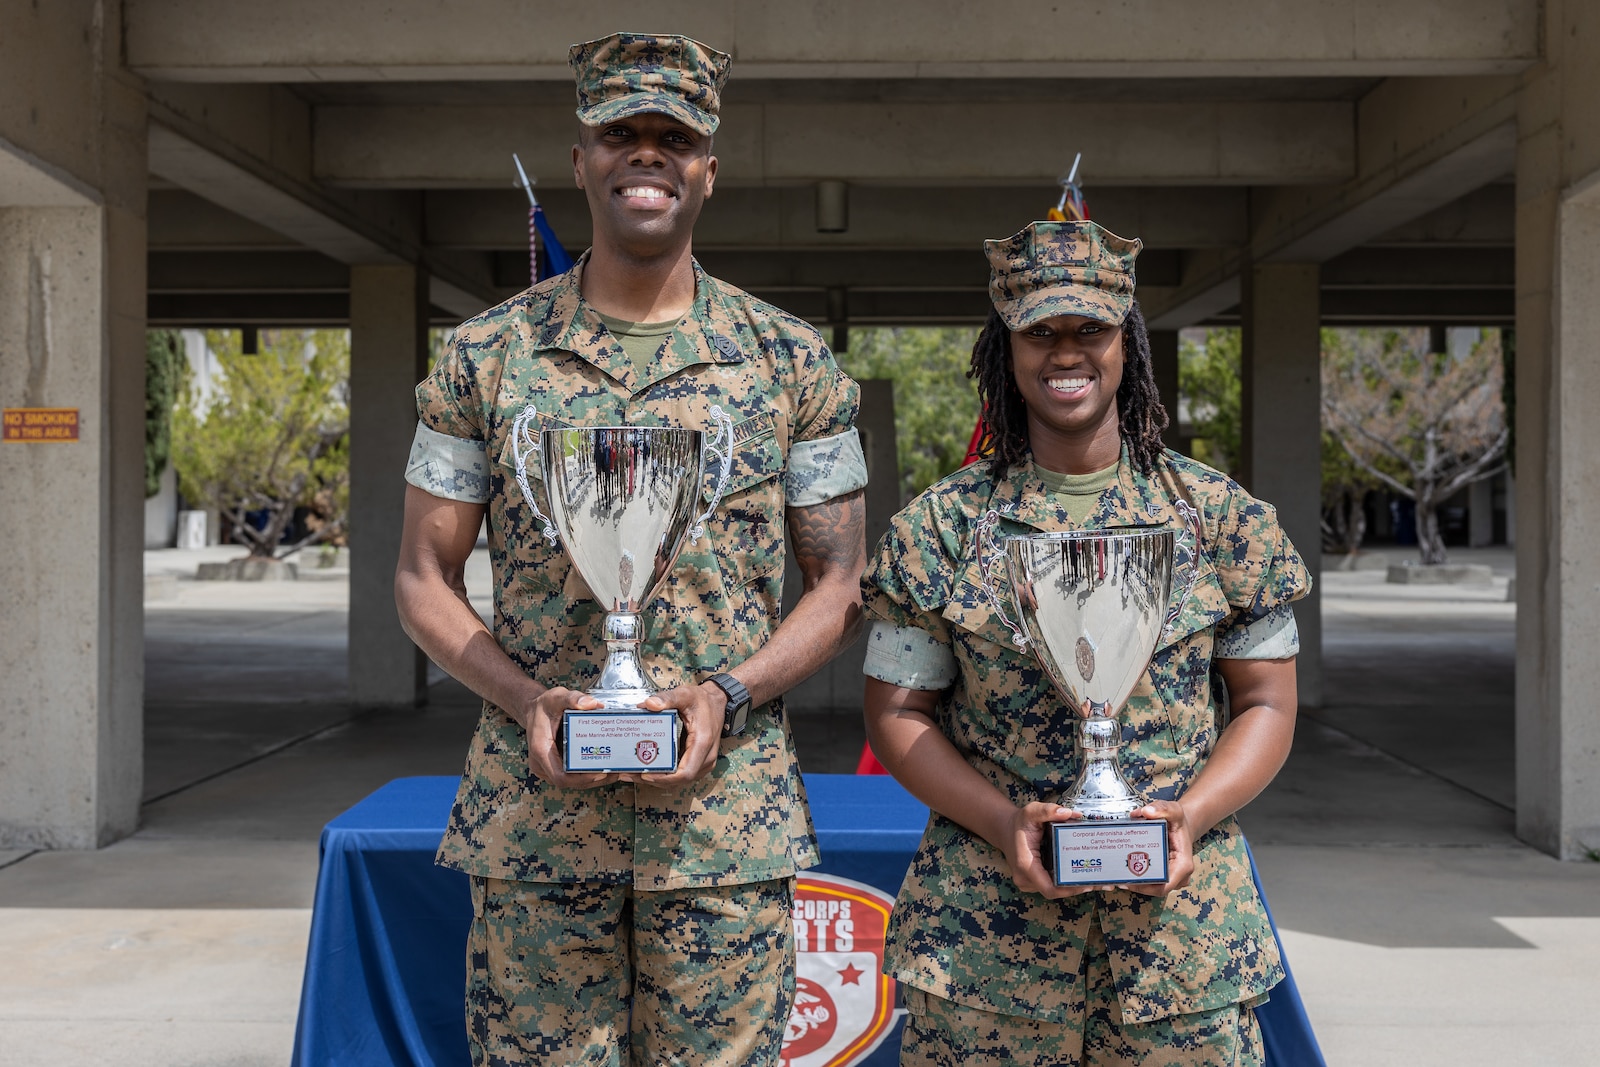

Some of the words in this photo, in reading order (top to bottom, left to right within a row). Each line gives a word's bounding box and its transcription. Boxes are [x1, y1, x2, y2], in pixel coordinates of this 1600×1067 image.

[4, 413, 22, 425] NO
[24, 413, 77, 425] SMOKING
[9, 427, 20, 437] IN
[22, 427, 42, 437] THIS
[44, 427, 71, 437] AREA
[793, 899, 851, 920] CORPS
